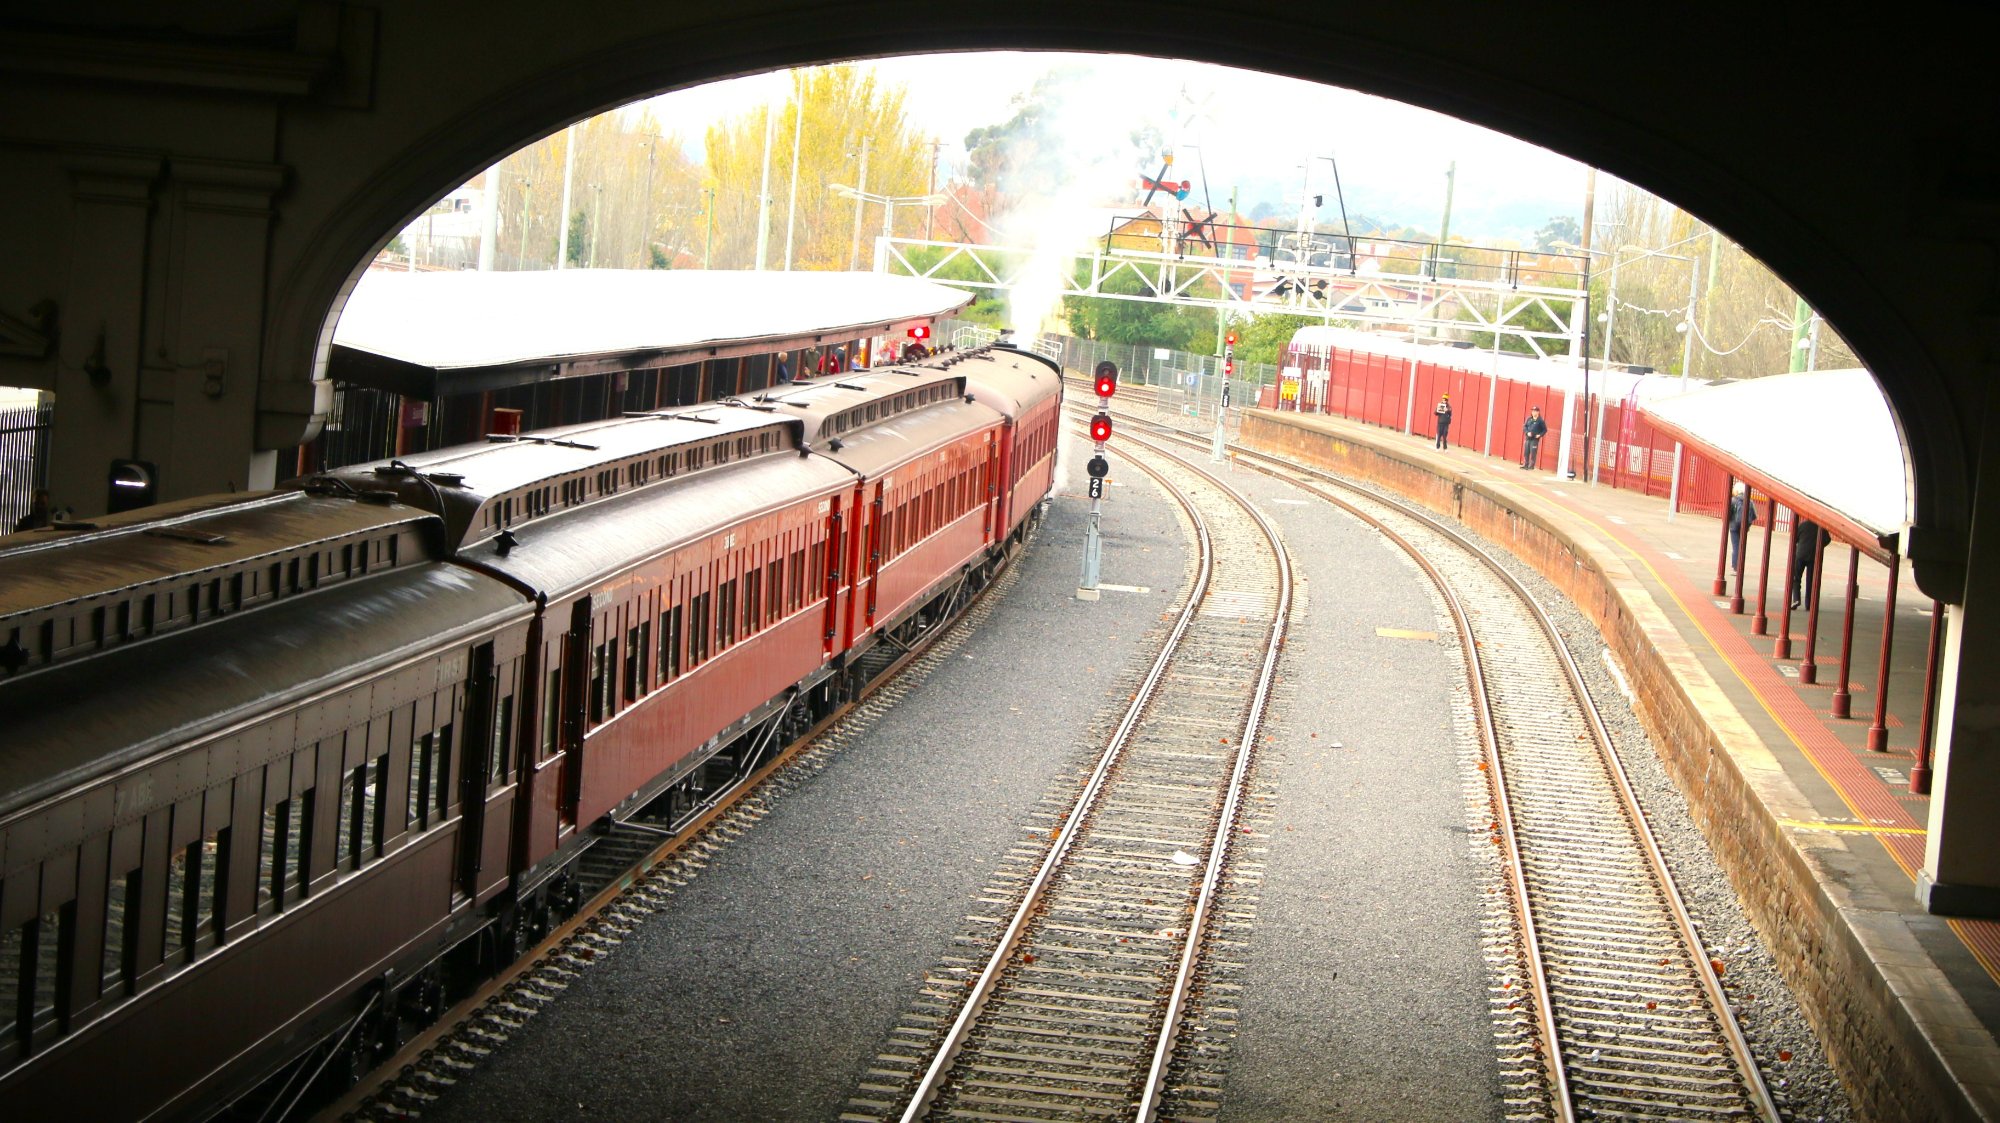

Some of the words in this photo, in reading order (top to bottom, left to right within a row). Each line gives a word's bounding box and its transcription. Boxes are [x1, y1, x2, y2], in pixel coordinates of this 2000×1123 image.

[1092, 479, 1100, 497] 26
[592, 588, 613, 610] SECOND
[434, 655, 465, 685] FIRST
